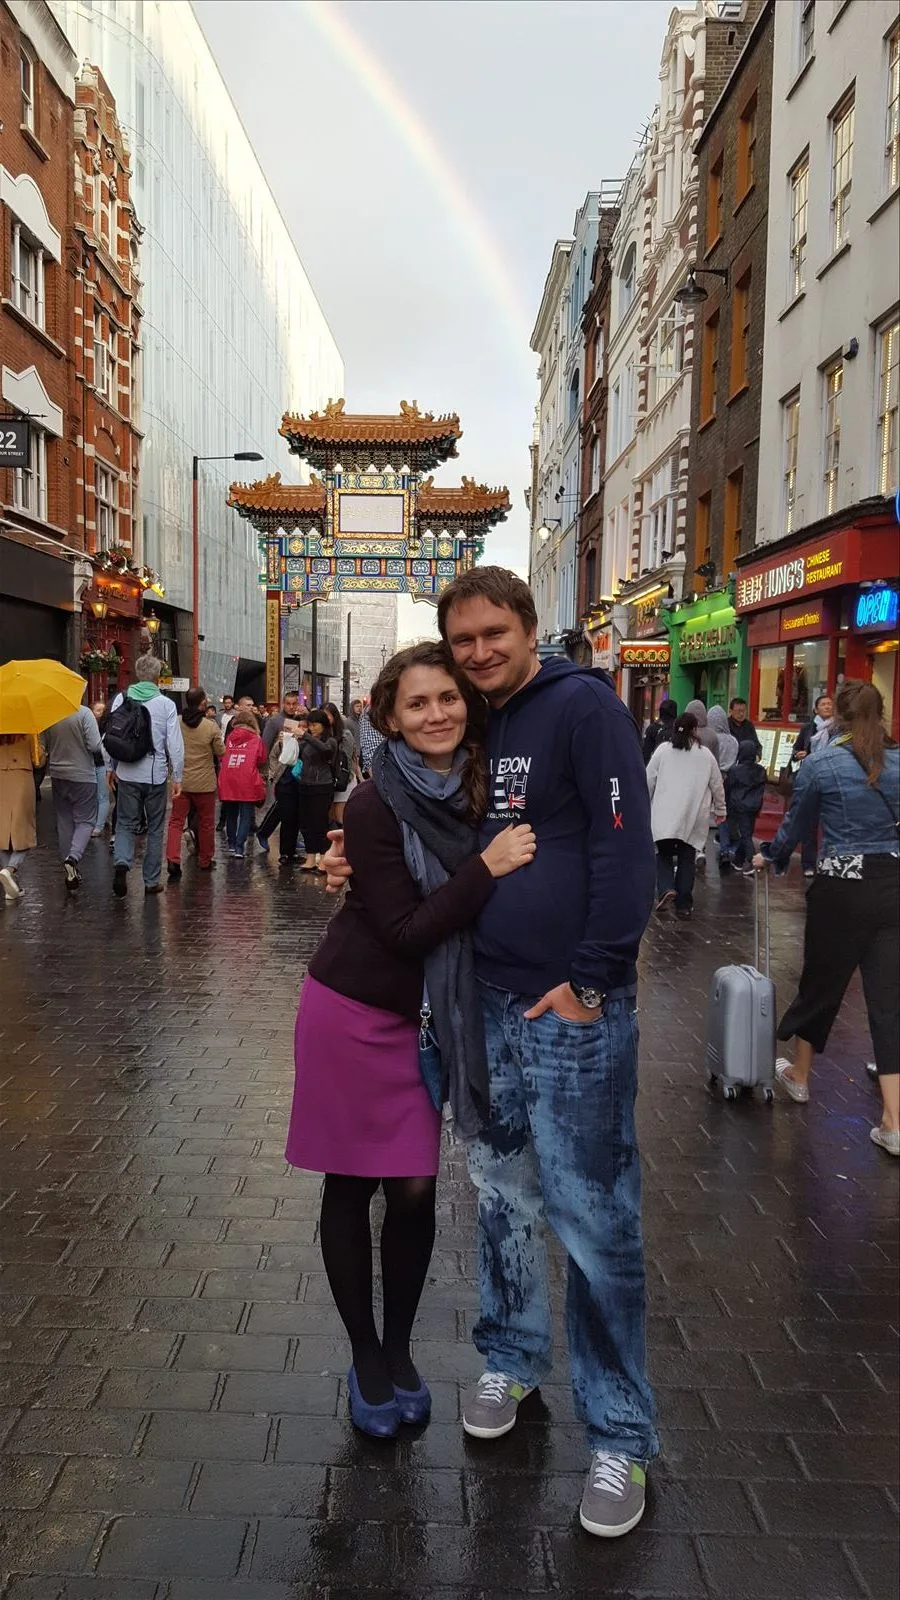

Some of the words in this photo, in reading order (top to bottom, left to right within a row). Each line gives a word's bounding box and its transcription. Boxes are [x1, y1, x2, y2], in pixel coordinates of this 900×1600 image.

[806, 548, 832, 568] CHINESE
[764, 557, 804, 599] HUNG'S
[806, 562, 843, 585] RESTAURANT
[857, 590, 892, 627] OPEN
[228, 754, 246, 768] EF
[610, 777, 623, 829] RLX
